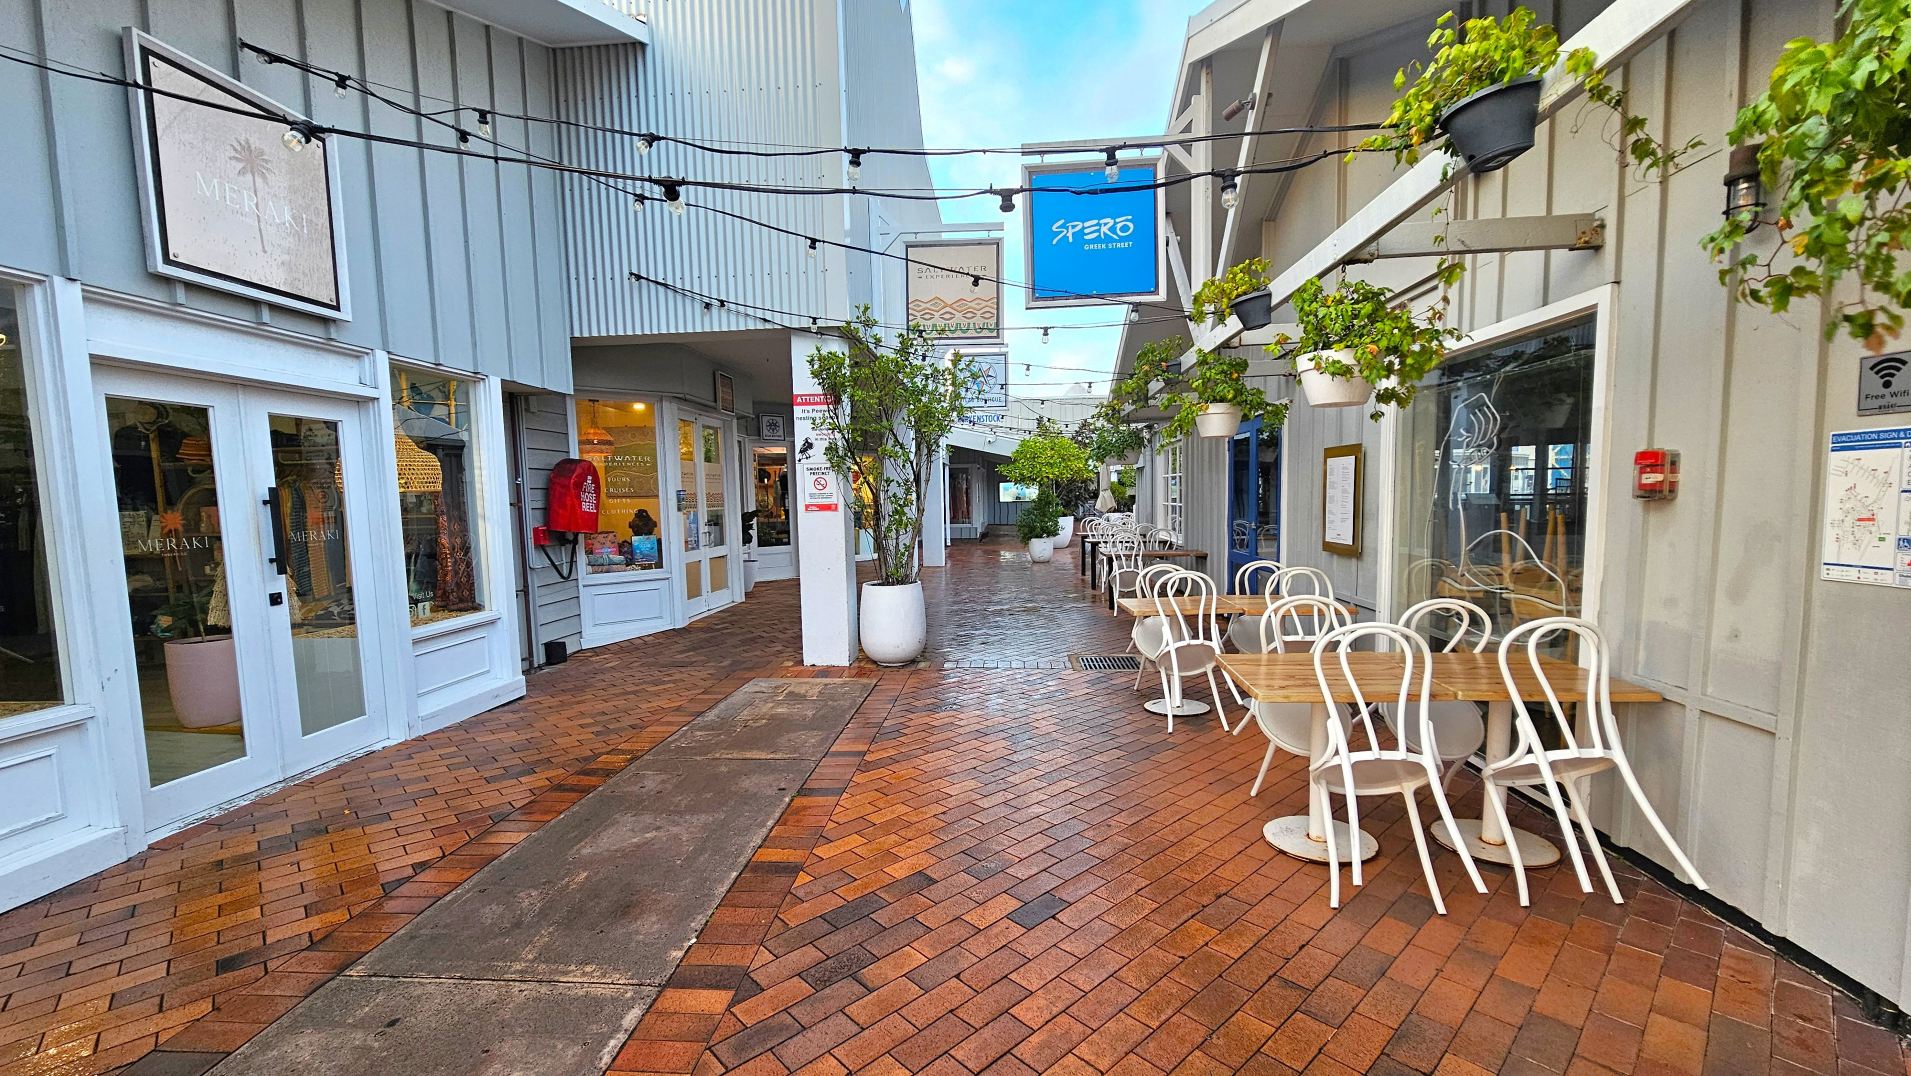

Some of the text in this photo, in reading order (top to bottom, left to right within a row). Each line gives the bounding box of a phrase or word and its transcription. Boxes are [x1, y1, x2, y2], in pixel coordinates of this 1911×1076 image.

[196, 171, 307, 233] MERAKI
[1108, 241, 1133, 249] STREET
[1865, 389, 1910, 401] Free Wifi
[1832, 432, 1878, 442] EVACUATION
[1880, 430, 1898, 439] SIGN
[1899, 430, 1905, 438] &
[582, 482, 596, 493] FIRE
[580, 491, 597, 504] HOSE
[581, 501, 597, 513] REEL
[289, 529, 339, 542] MERAKI
[137, 536, 209, 552] MERAKI
[425, 590, 434, 598] Us
